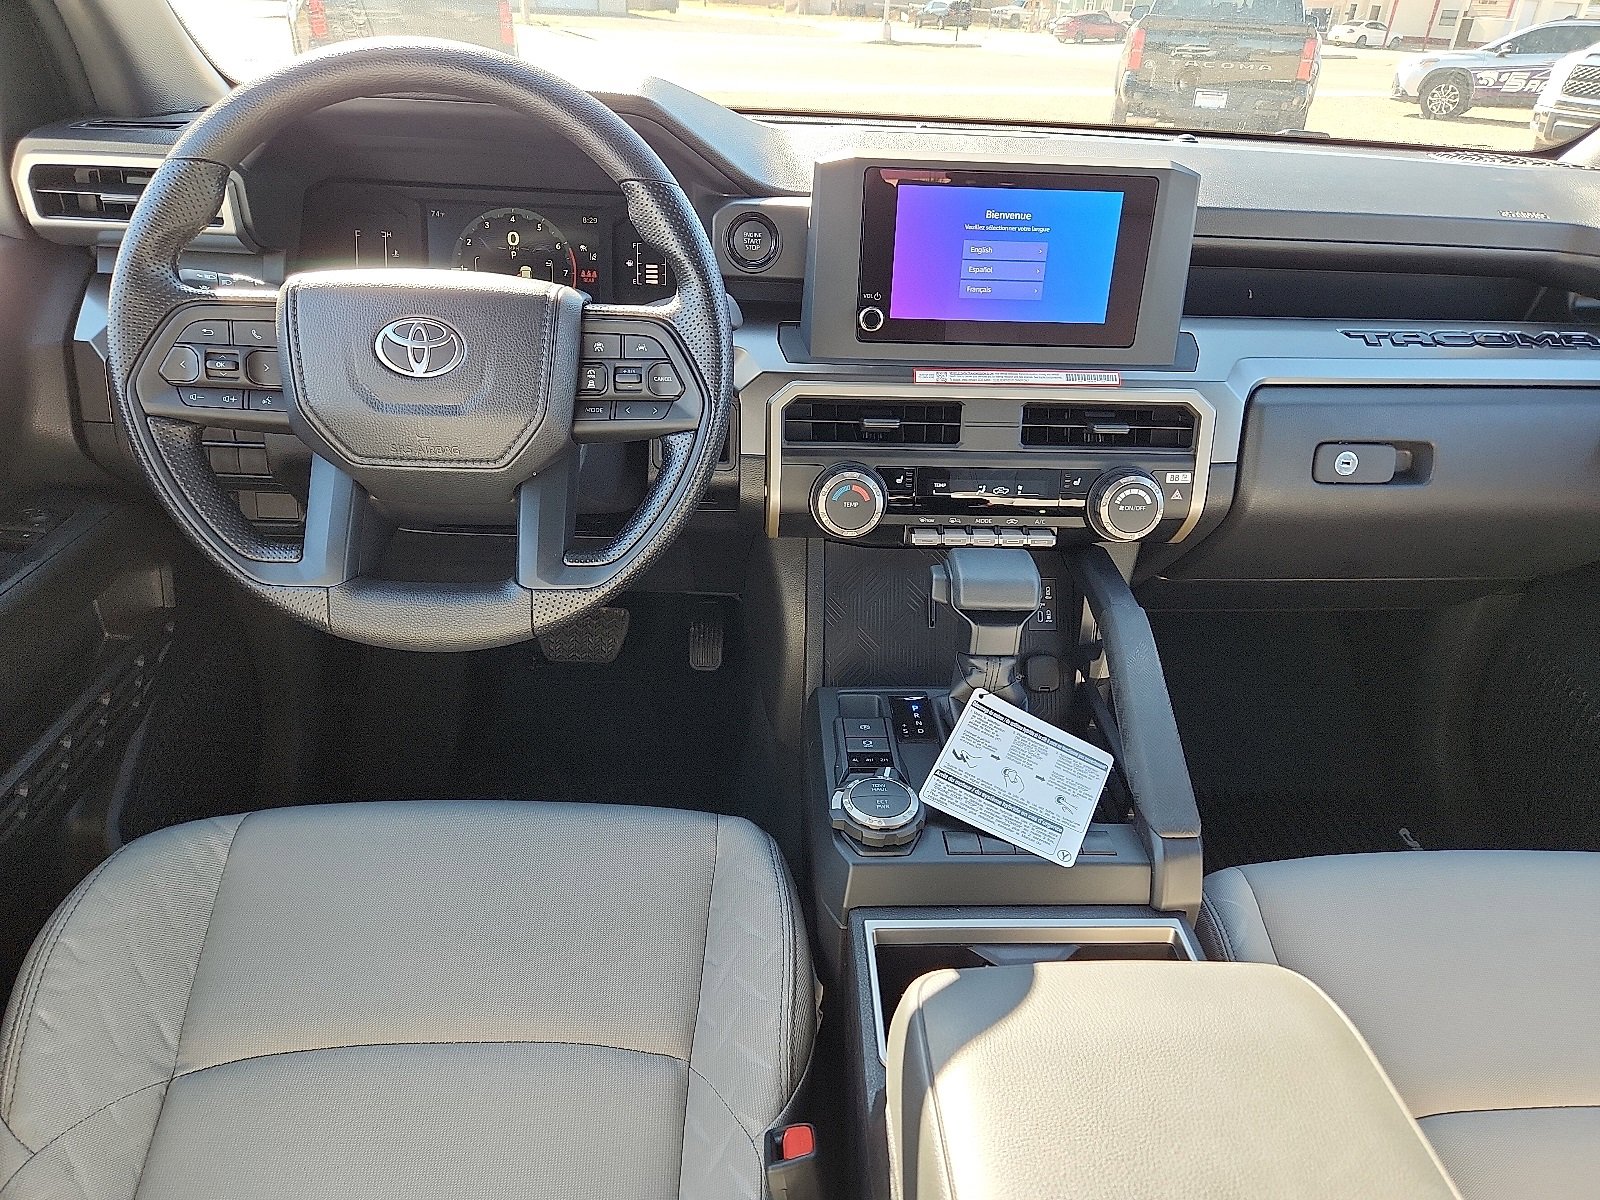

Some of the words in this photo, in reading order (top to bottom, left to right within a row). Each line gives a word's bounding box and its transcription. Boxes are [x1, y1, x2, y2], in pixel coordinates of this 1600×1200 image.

[510, 215, 516, 223] 4
[985, 209, 1032, 221] Bienvenue
[484, 221, 490, 229] 3
[536, 223, 542, 231] 5
[1031, 226, 1051, 234] langue
[466, 238, 472, 246] 2
[555, 242, 561, 250] 6
[970, 246, 993, 255] English
[511, 251, 517, 259] P
[563, 269, 569, 277] 7
[968, 266, 993, 274] Español
[966, 286, 992, 294] Français
[1336, 328, 1600, 350] TACOMA
[389, 443, 412, 455] SRS
[417, 444, 461, 456] AIRBAG
